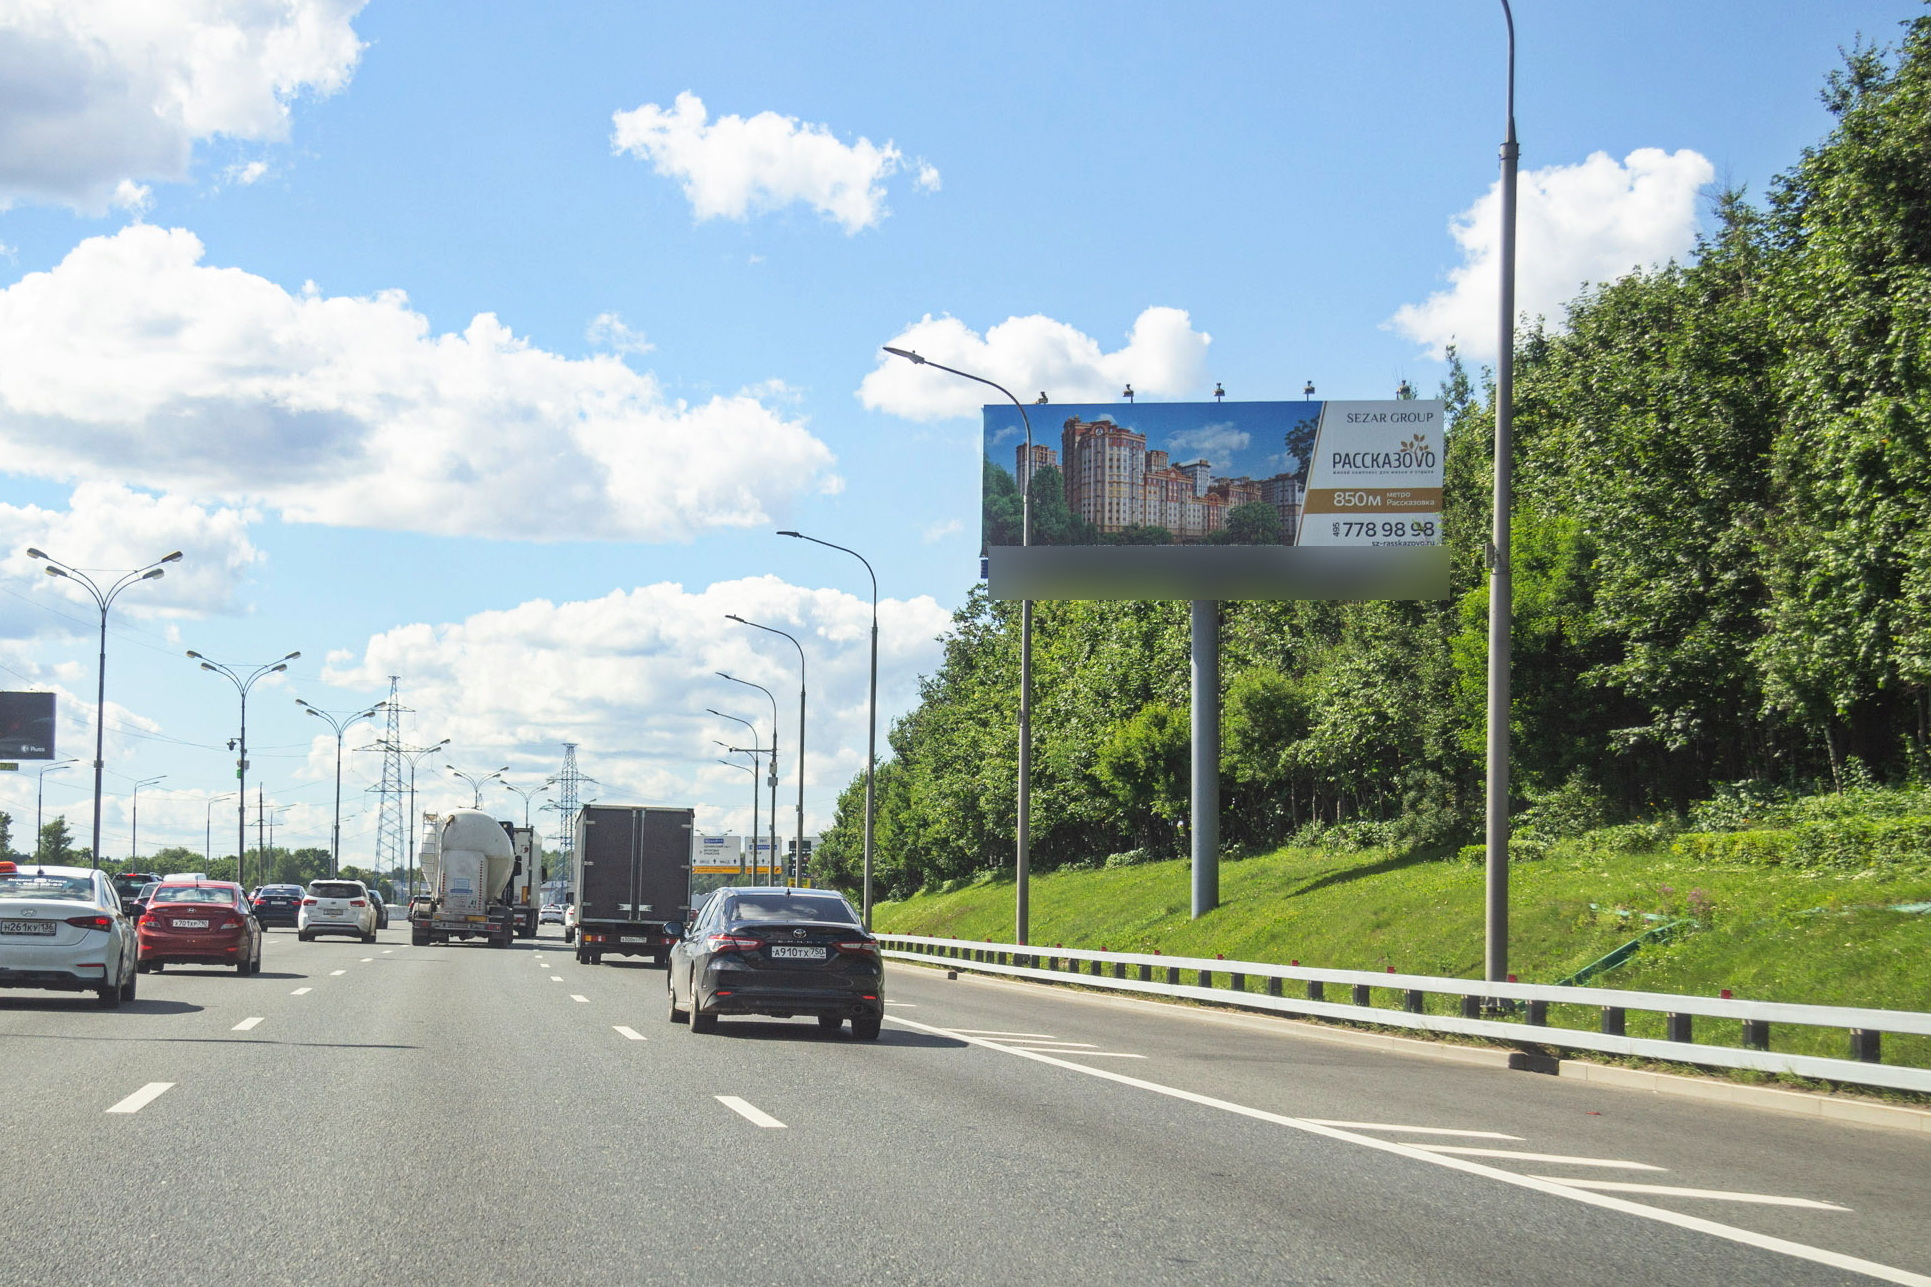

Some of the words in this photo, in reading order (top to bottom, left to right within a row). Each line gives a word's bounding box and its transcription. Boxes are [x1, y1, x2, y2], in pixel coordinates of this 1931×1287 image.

[1346, 412, 1387, 423] SEZAR
[1390, 412, 1434, 423] GROUP
[1332, 522, 1340, 537] 495
[1343, 522, 1377, 537] 778
[1382, 522, 1405, 537] 98
[1410, 522, 1435, 537] 98
[774, 947, 809, 957] А910ТХ
[810, 948, 824, 956] 750
